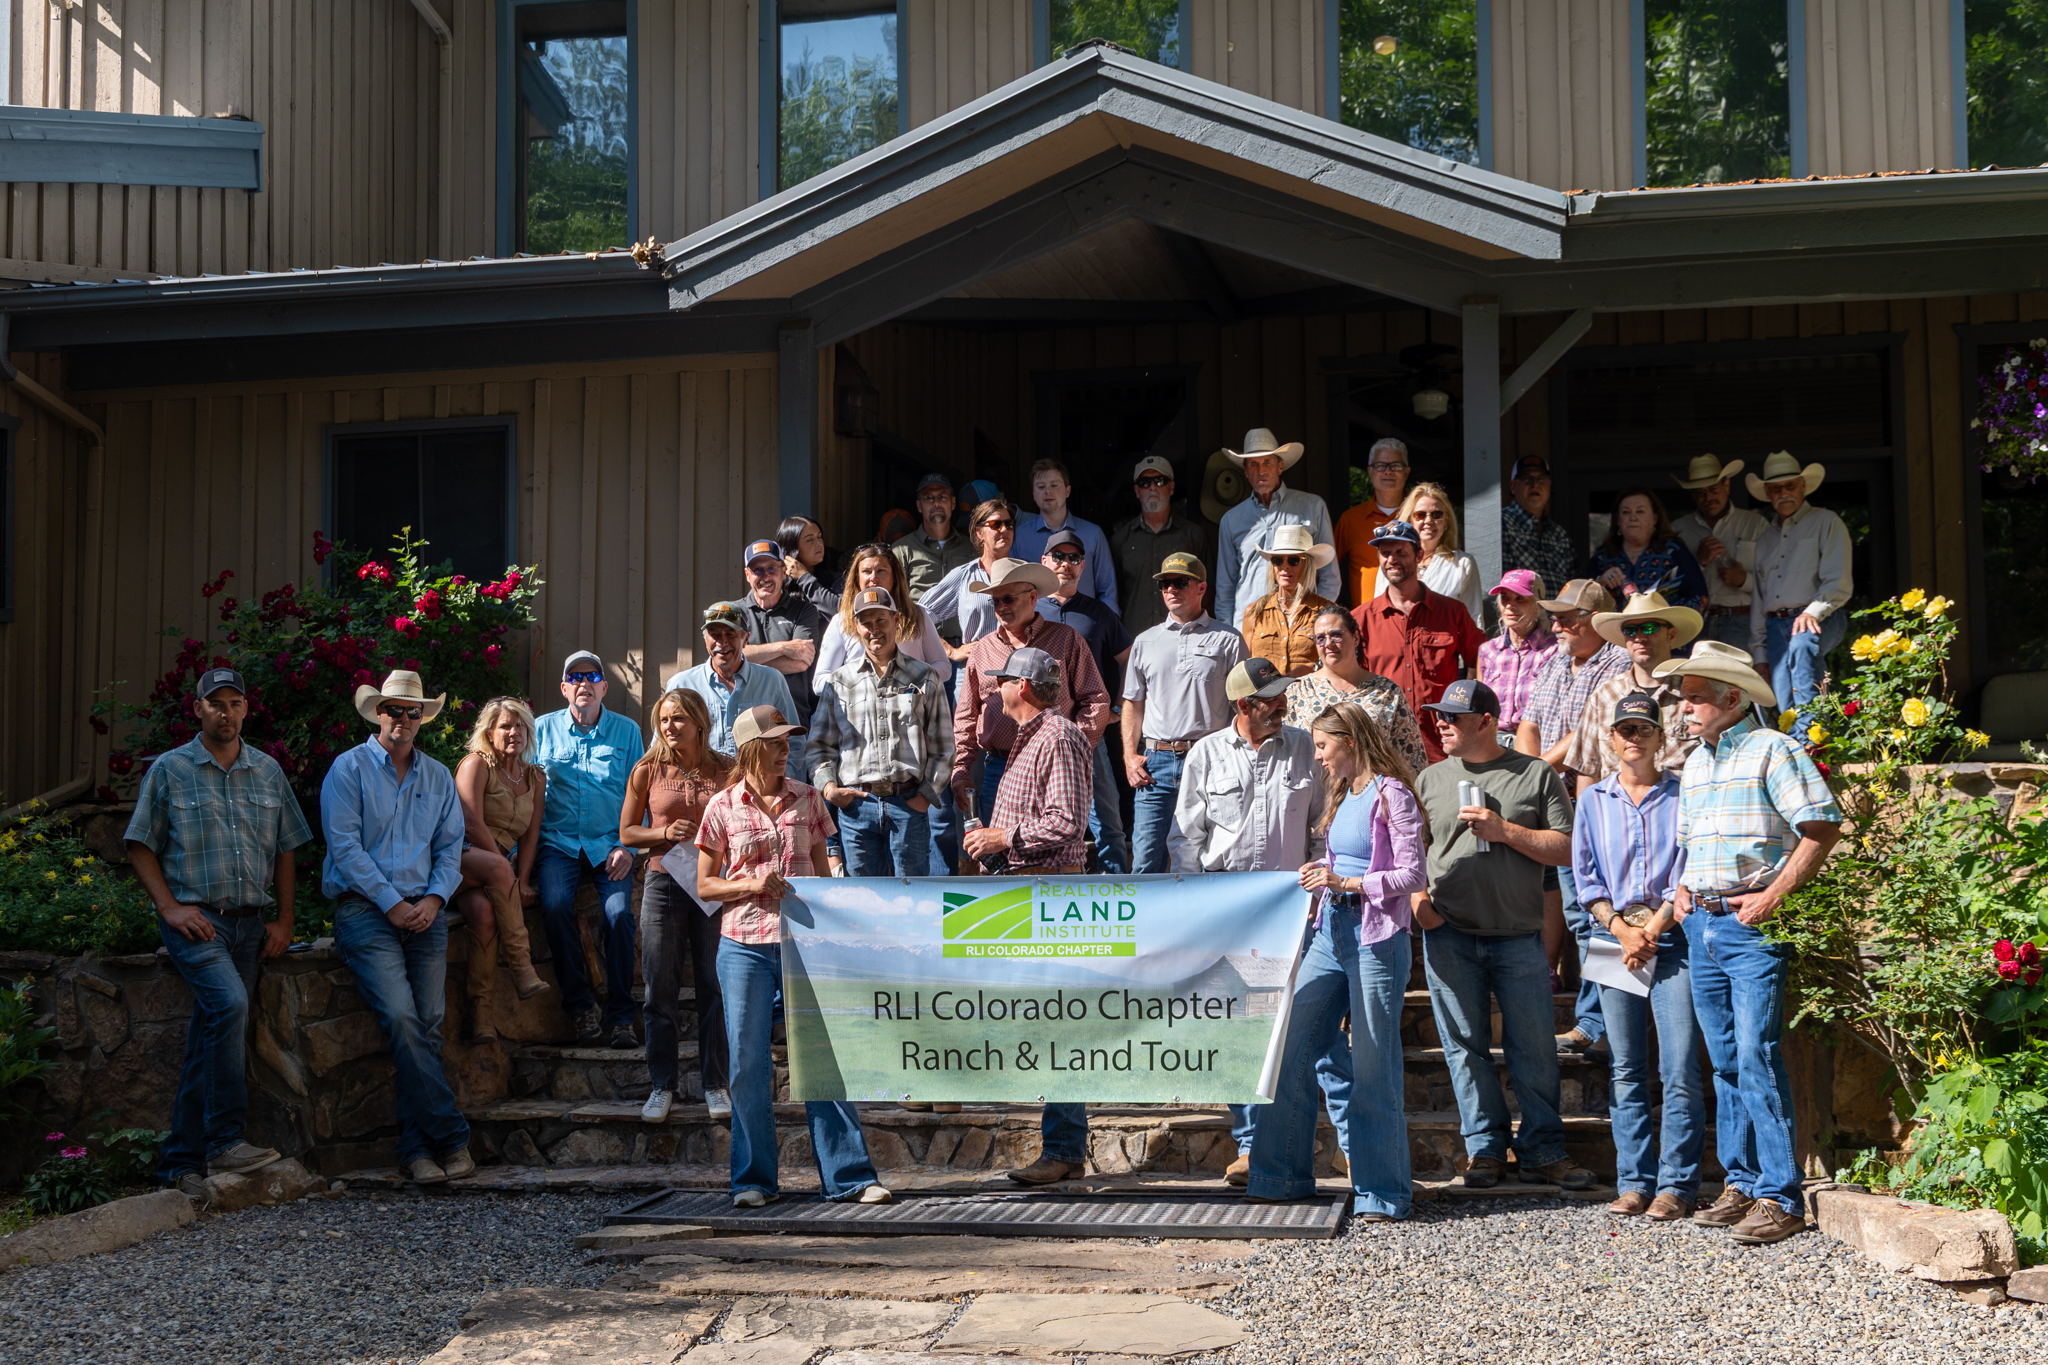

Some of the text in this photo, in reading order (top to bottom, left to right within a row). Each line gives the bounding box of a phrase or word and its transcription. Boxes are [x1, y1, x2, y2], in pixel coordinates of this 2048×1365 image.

[1040, 901, 1136, 922] LAND
[1040, 925, 1136, 938] INSTITUTE
[966, 945, 1113, 956] RLI COLORADO CHAPTER
[873, 989, 1238, 1028] RLI Colorado Chapter
[901, 1040, 1219, 1072] Ranch & Land Tour
